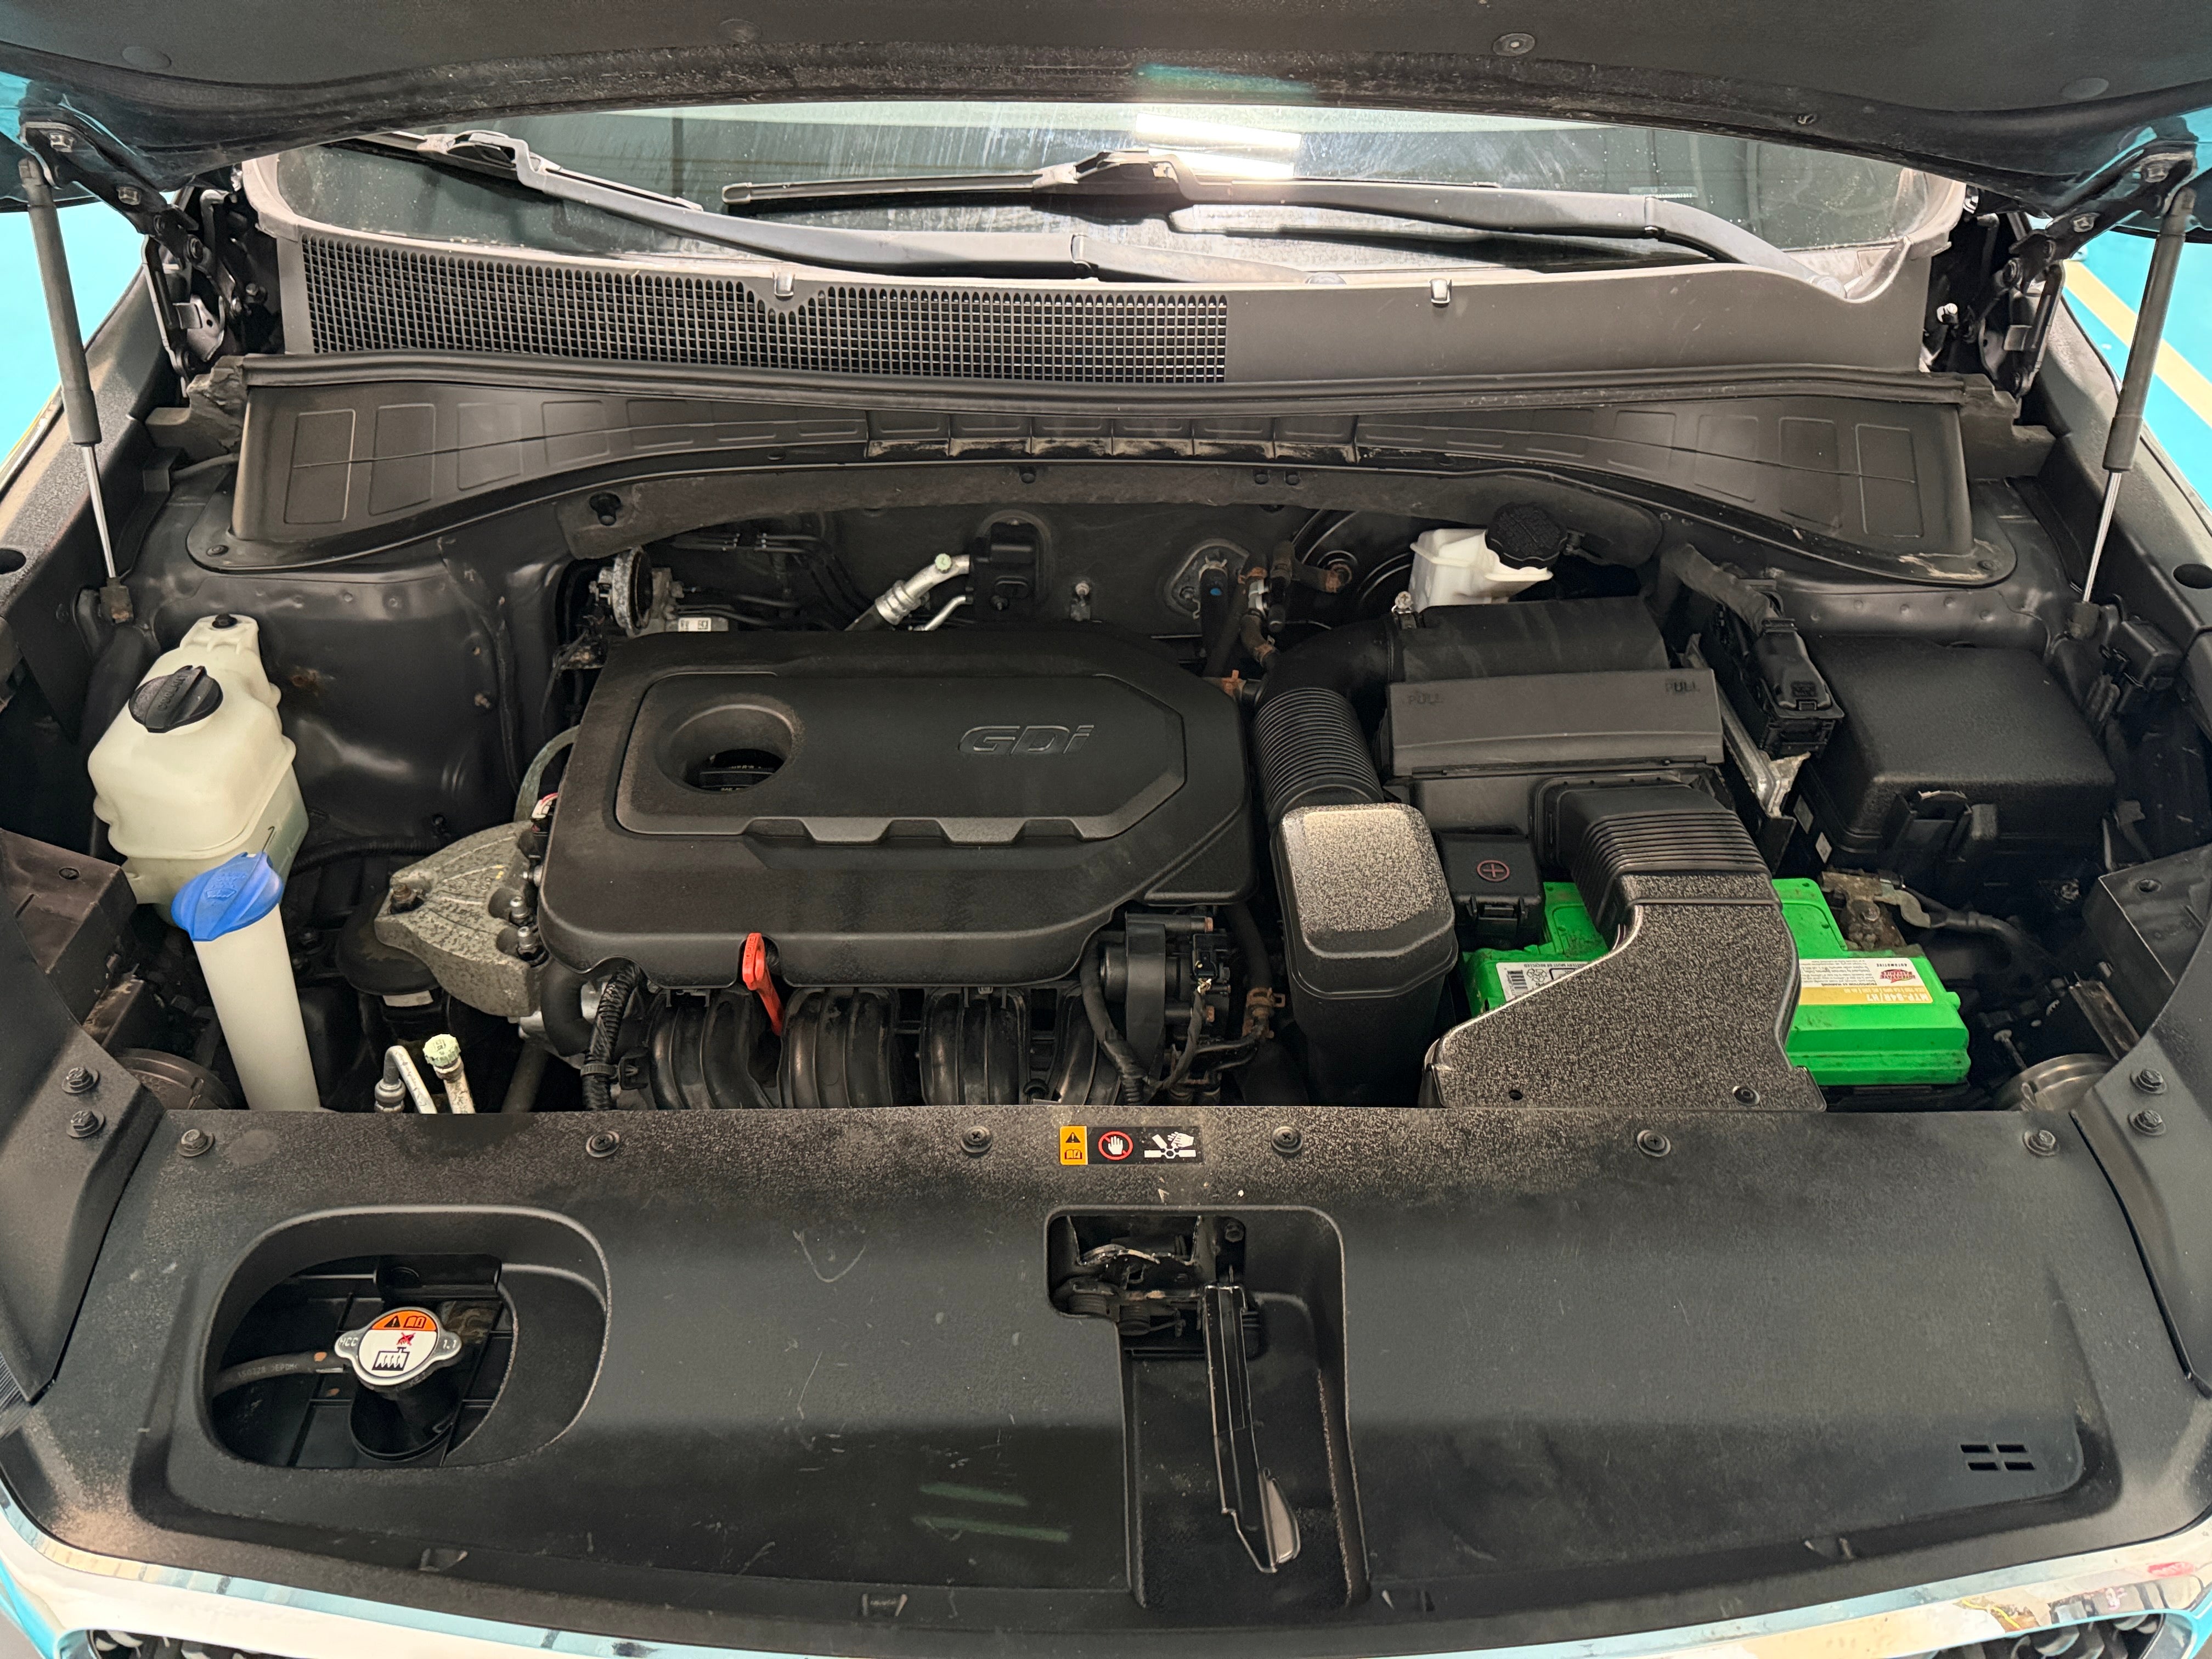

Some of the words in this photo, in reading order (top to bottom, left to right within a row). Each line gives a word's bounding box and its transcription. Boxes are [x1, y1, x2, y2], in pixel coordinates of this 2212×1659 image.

[1666, 681, 1700, 692] PULL
[1408, 693, 1443, 704] PULL
[957, 725, 1095, 755] GDi
[339, 1337, 359, 1347] HCC
[443, 1339, 457, 1350] 1.1
